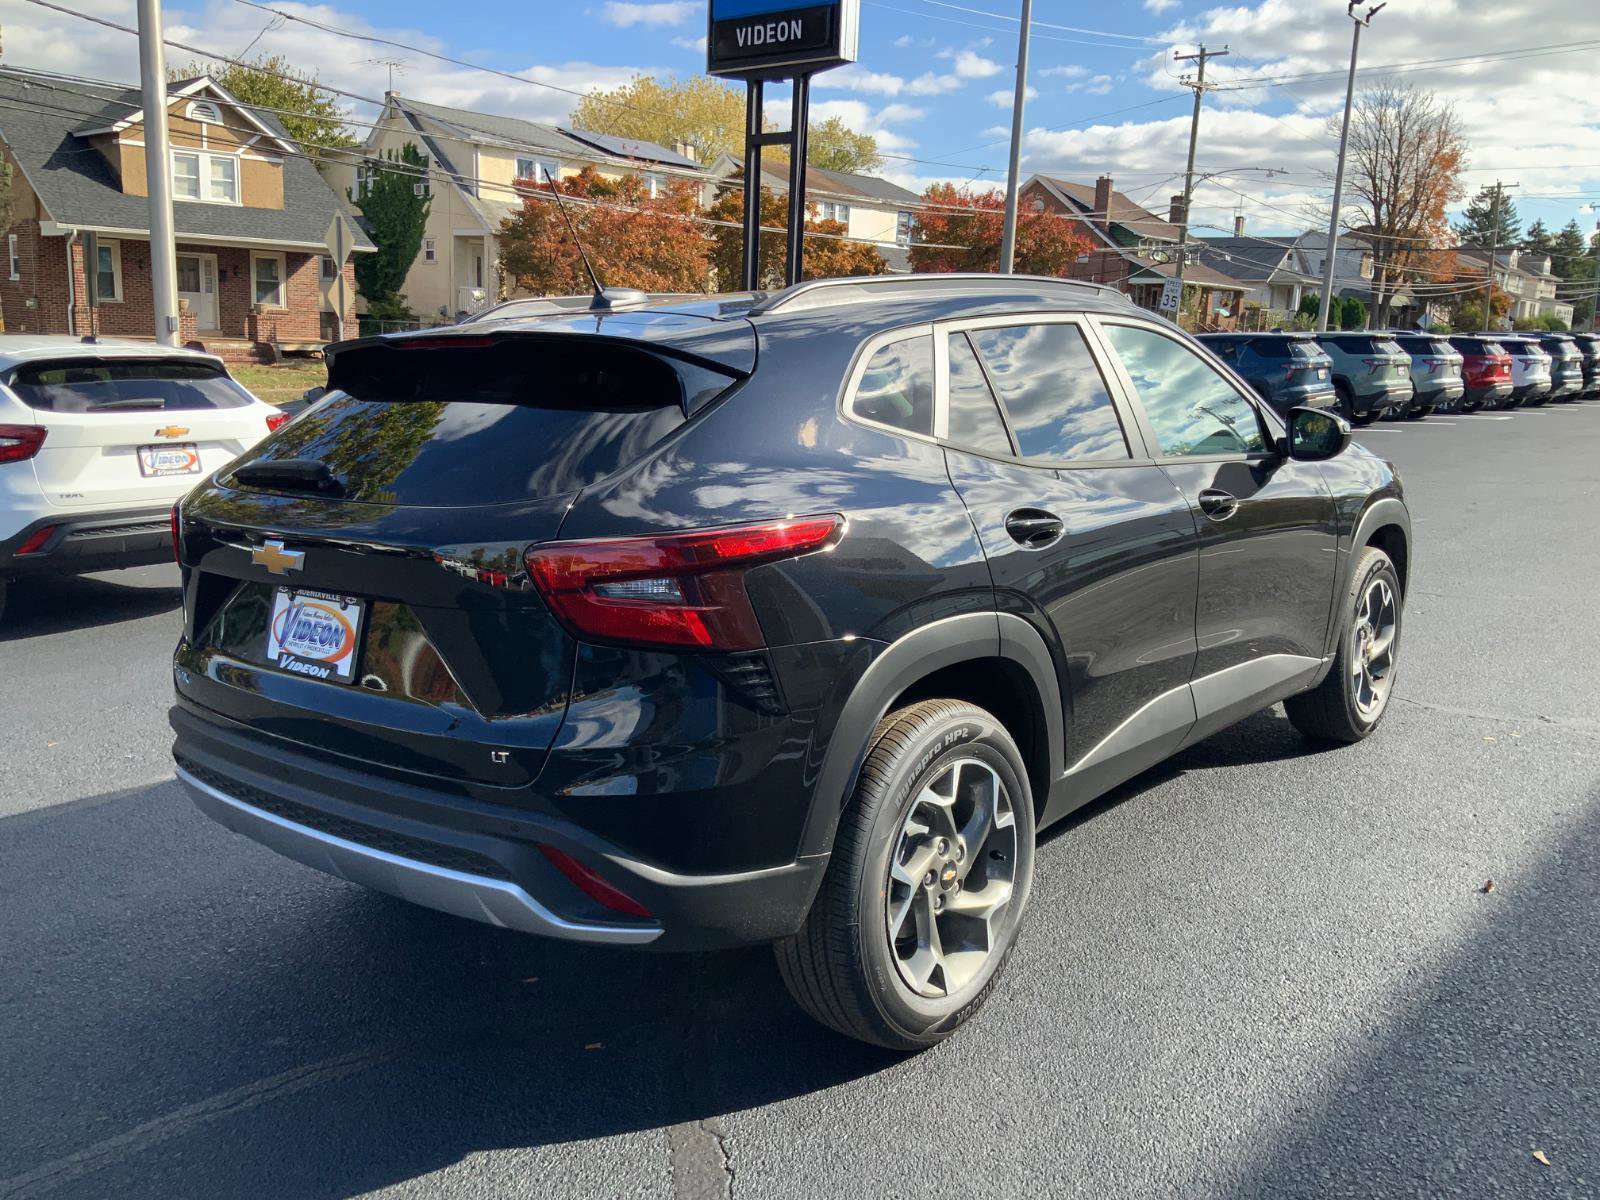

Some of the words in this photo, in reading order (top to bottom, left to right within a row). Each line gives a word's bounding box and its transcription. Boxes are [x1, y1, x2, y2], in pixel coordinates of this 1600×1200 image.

[736, 19, 802, 47] VIDEON
[1162, 294, 1178, 308] 35
[279, 602, 346, 650] VIDEON
[280, 654, 330, 678] VIDEON
[944, 728, 968, 746] HP2
[491, 751, 510, 764] LT
